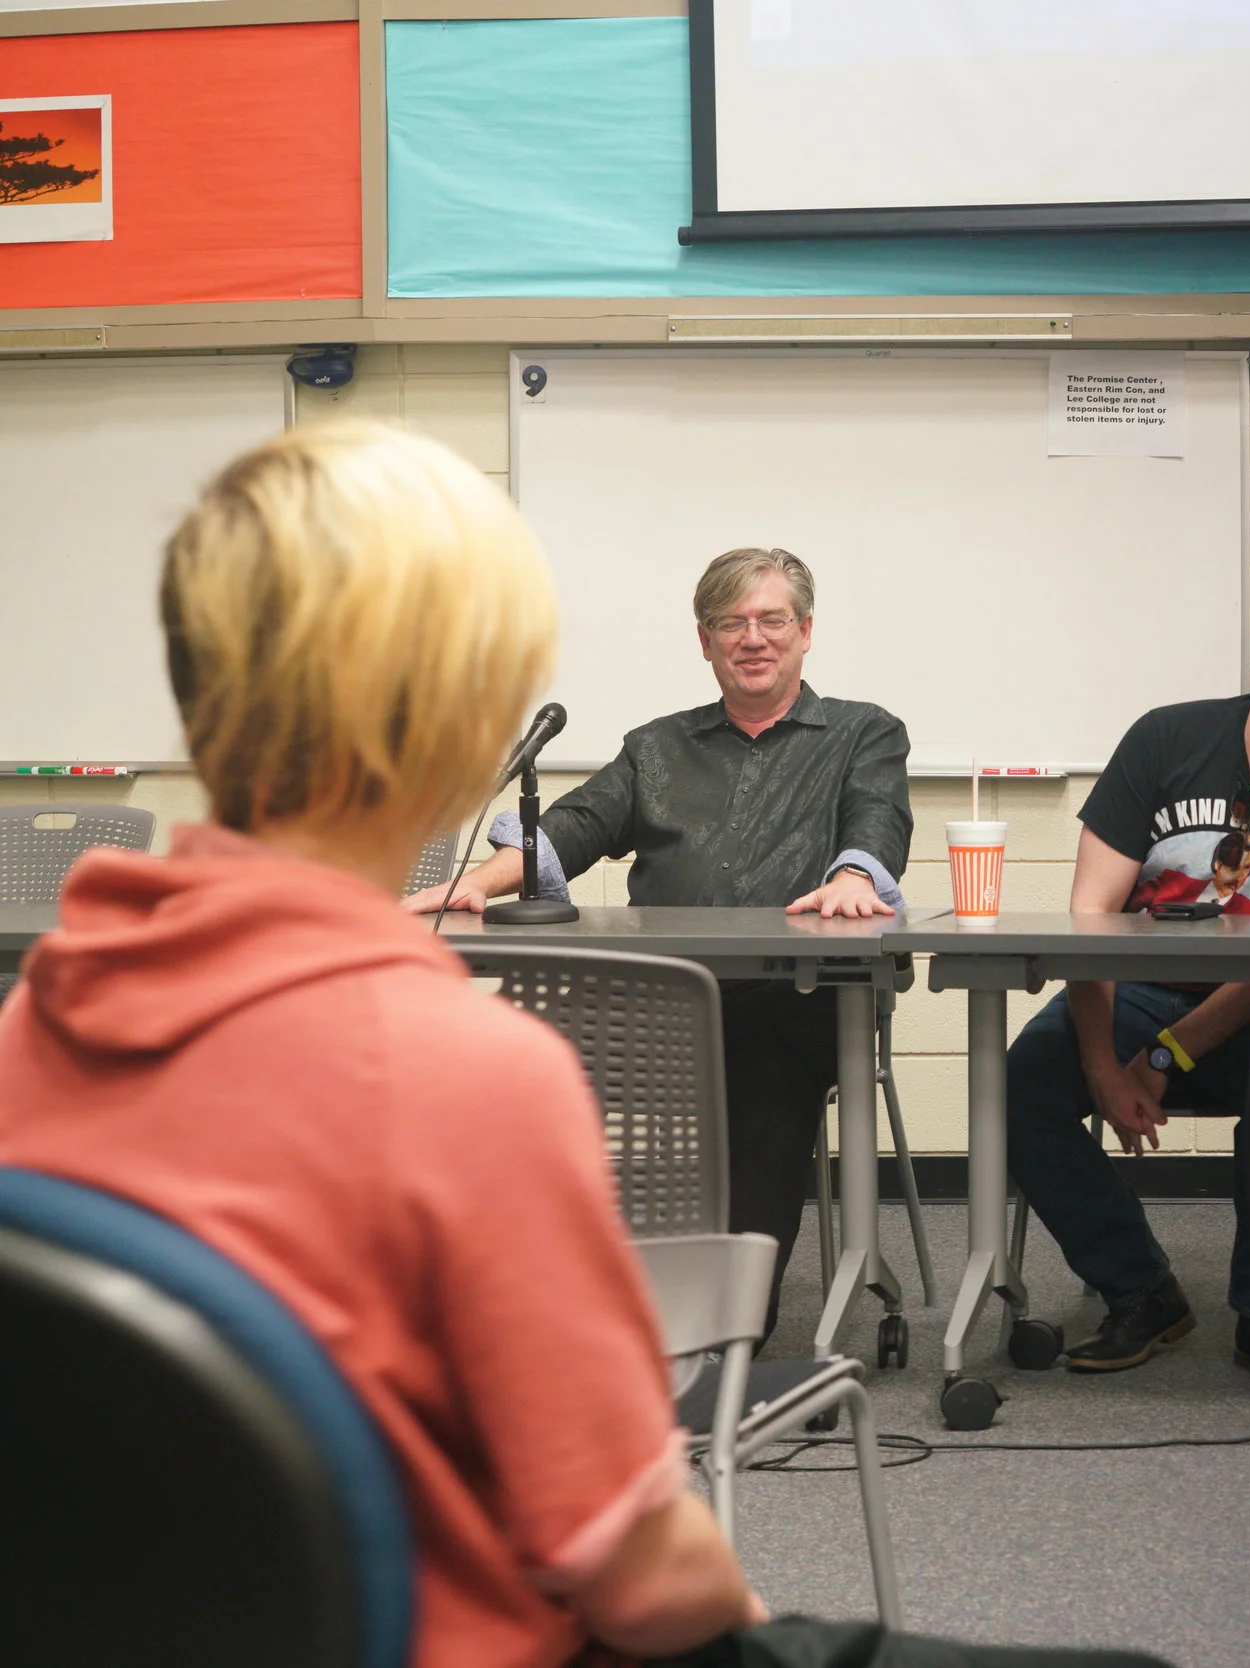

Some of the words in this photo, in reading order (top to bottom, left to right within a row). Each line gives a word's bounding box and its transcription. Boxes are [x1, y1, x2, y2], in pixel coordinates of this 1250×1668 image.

[522, 365, 547, 397] 9
[1067, 375, 1084, 383] The
[1087, 375, 1124, 383] Promise
[1127, 376, 1158, 384] Center
[1067, 385, 1103, 393] Eastern
[1105, 385, 1123, 393] Rim
[1125, 386, 1146, 395] Con,
[1148, 386, 1166, 394] and
[1067, 395, 1084, 403] Lee
[1086, 395, 1121, 404] College
[1067, 405, 1120, 414] responsible
[1137, 406, 1155, 414] lost
[1067, 415, 1095, 423] stolen
[1097, 416, 1123, 424] items
[1137, 416, 1166, 426] injury.
[1175, 798, 1227, 828] KIND
